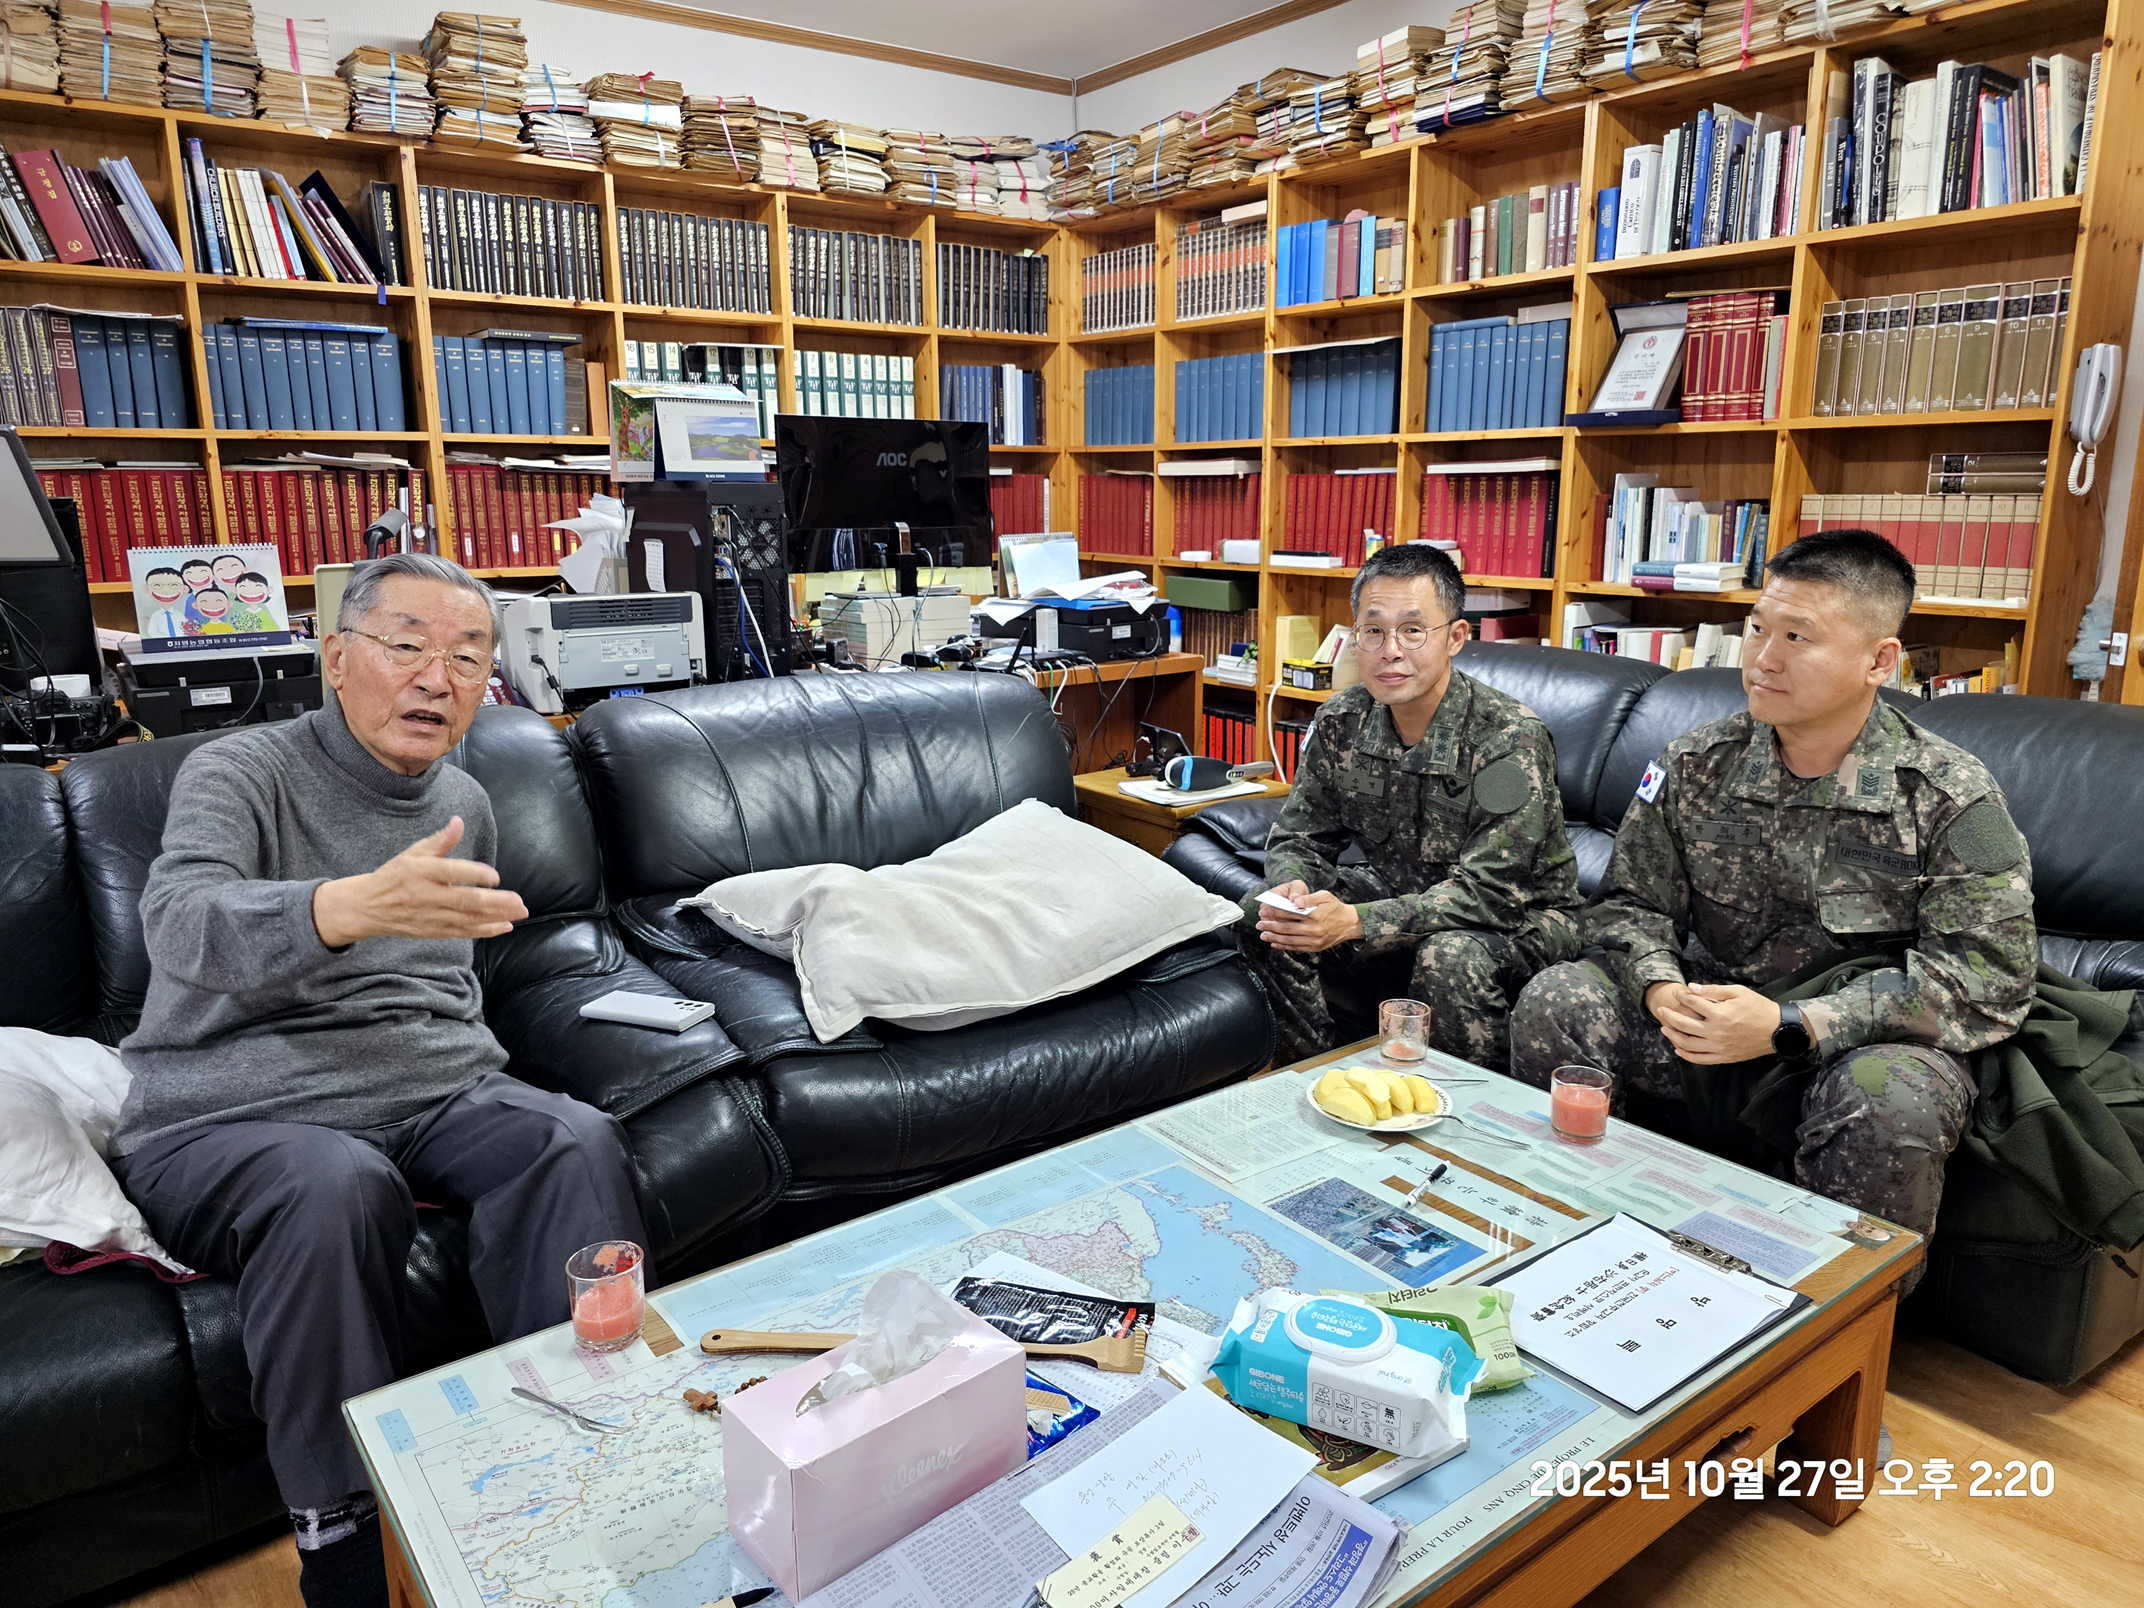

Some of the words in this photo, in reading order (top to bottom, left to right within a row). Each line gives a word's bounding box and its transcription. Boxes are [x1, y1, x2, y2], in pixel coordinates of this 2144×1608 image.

[36, 167, 57, 200] 규정집
[1974, 324, 1981, 332] 9
[625, 343, 635, 353] 16
[645, 344, 655, 355] 15
[668, 345, 676, 355] 14
[708, 348, 717, 358] 12
[746, 349, 754, 359] 10
[766, 350, 772, 360] 9
[810, 354, 816, 363] 7
[828, 354, 834, 363] 6
[846, 356, 852, 365] 5
[863, 356, 869, 366] 4
[878, 357, 884, 367] 3
[893, 358, 898, 368] 2
[0, 366, 11, 374] 25
[22, 366, 33, 375] 26
[42, 366, 52, 375] 27
[876, 452, 908, 467] AOC
[1841, 846, 1881, 864] 대한민국
[1882, 855, 1900, 869] 육군
[1591, 1277, 1630, 1305] 프란치스코
[1689, 1294, 1713, 1309] 방
[1561, 1299, 1595, 1324] 사베리오
[1315, 1321, 1353, 1338] GIBONE
[1654, 1316, 1678, 1331] 명
[1615, 1338, 1643, 1354] 록
[1247, 1366, 1285, 1384] GIBONE
[1438, 1346, 1457, 1394] GIBONE
[1384, 1407, 1396, 1421] 無
[1580, 1436, 1595, 1448] LE
[882, 1441, 967, 1502] Kleenex
[1531, 1468, 1547, 1481] DE
[1503, 1479, 1532, 1499] CINQ
[1482, 1496, 1505, 1513] ANS
[1272, 1494, 1313, 1544] 이벤트성
[1321, 1509, 1334, 1529] 2025년
[1449, 1515, 1473, 1536] POUR
[1426, 1531, 1444, 1548] LA
[1066, 1584, 1081, 1597] 25년
[1132, 1527, 1156, 1548] 포상휴가
[1150, 1548, 1171, 1567] 중령
[1234, 1537, 1277, 1580] 시노드는
